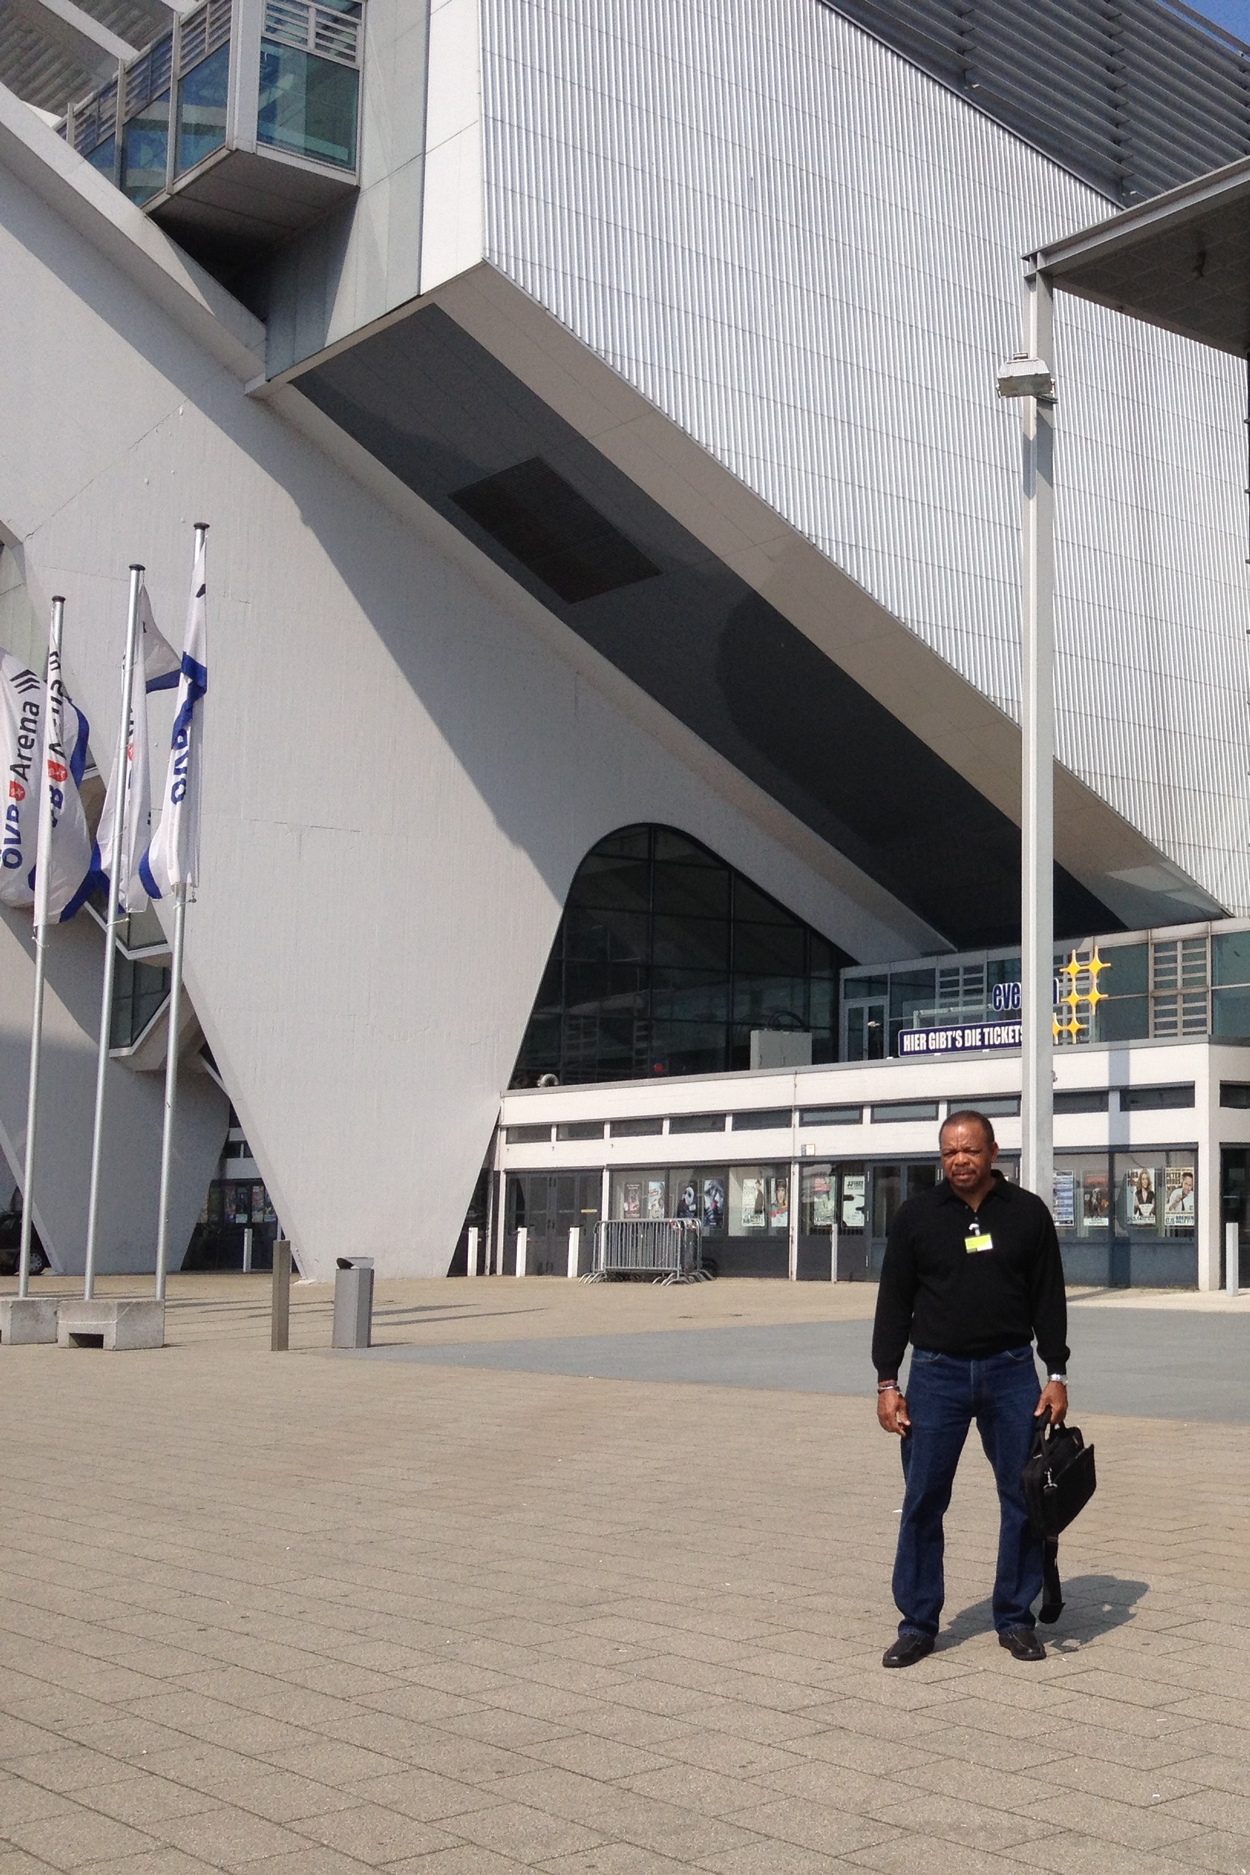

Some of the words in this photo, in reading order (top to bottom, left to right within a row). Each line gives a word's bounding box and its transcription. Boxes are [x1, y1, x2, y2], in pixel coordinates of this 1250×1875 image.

[10, 700, 40, 783] Arena
[903, 1031, 927, 1052] HIER
[928, 1029, 963, 1050] GIBT'S
[964, 1027, 982, 1047] DIE
[983, 1024, 1023, 1046] TICKET
